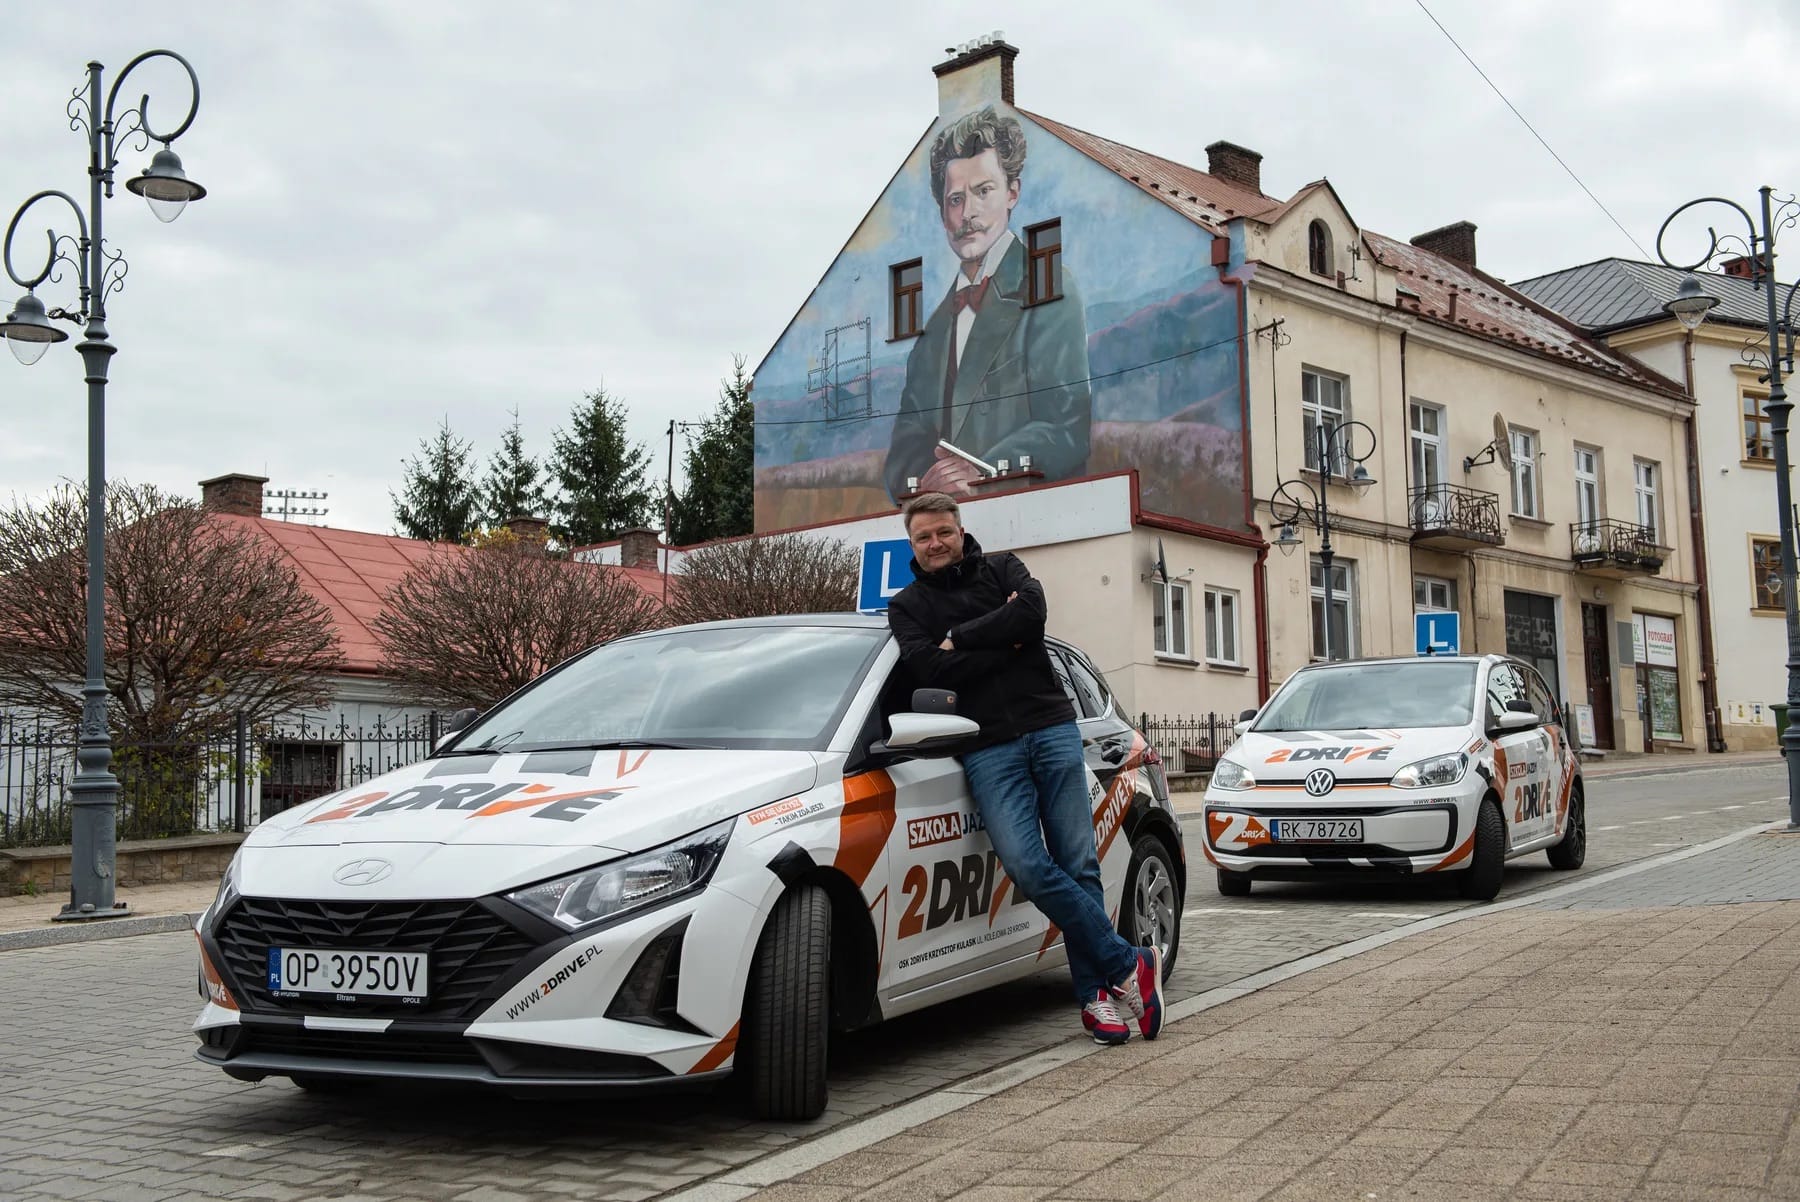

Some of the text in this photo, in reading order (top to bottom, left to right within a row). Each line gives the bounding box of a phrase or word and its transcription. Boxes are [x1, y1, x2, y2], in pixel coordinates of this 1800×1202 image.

[880, 551, 906, 598] L
[1429, 619, 1448, 647] L
[1265, 744, 1396, 764] 2DRIVE
[304, 782, 640, 822] 2DRIVE
[1095, 766, 1135, 851] DRIVE.PL
[1515, 773, 1551, 823] 2DRIVE
[909, 815, 961, 845] SZKOŁA
[1281, 822, 1358, 838] RK 78726
[898, 959, 910, 969] OSK
[910, 952, 928, 966] 2DRIVE
[928, 943, 956, 960] KRZYSZTOF
[956, 937, 976, 950] KULASIK
[271, 973, 280, 983] PL
[287, 952, 419, 992] OP 3950V
[506, 945, 603, 1020] WWW.2DRIVE.PL
[336, 993, 356, 1002] Eltrans
